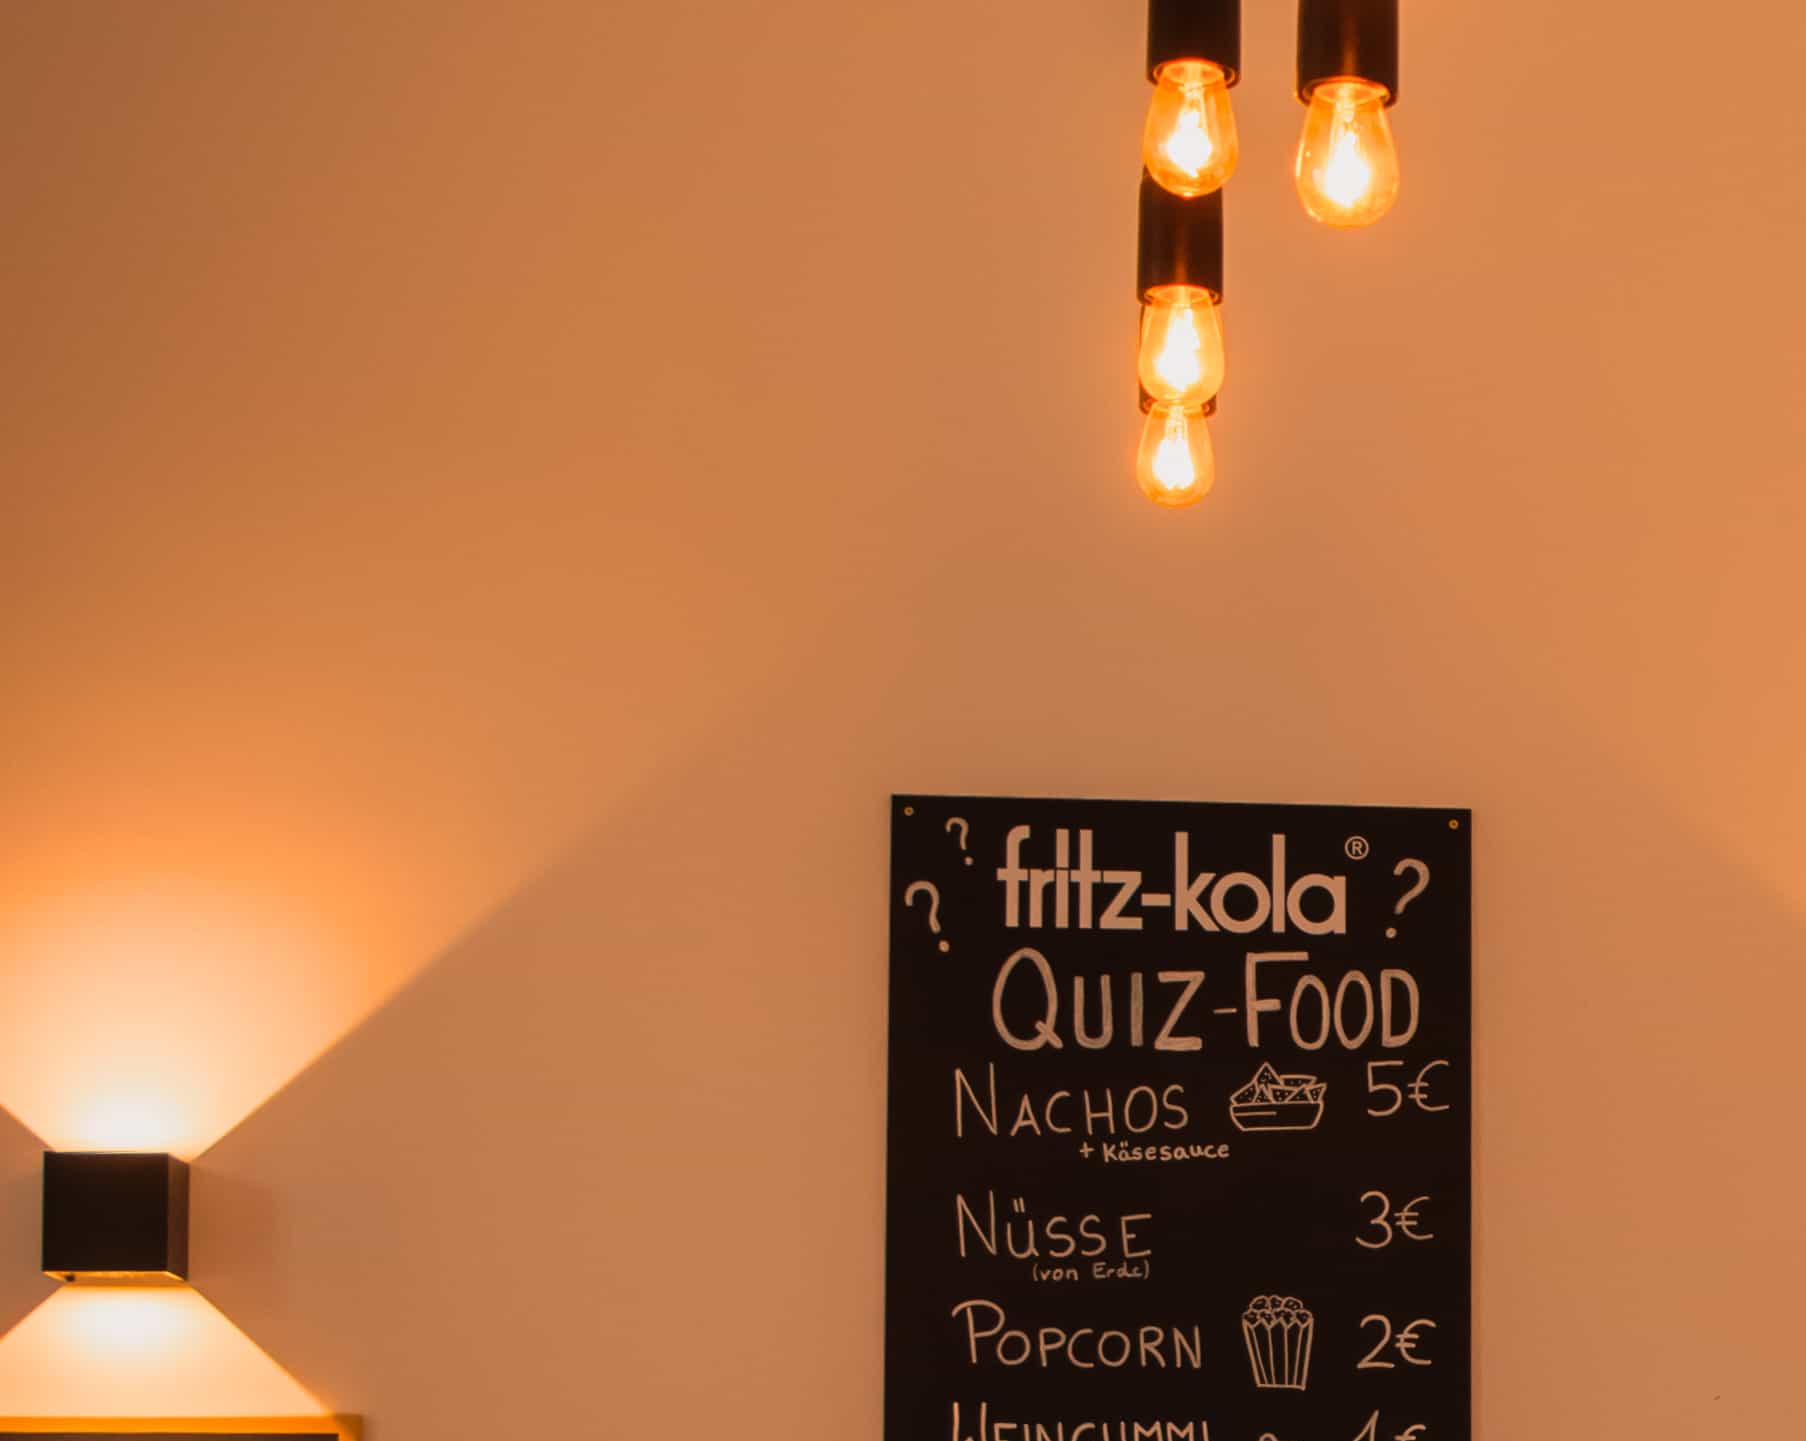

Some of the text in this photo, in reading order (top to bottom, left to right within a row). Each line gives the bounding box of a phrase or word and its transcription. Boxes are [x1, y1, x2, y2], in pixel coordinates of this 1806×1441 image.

[954, 1061, 1189, 1138] NACHOS
[1079, 1140, 1231, 1163] + Käsesauce
[1032, 1263, 1079, 1282] (von
[951, 1299, 1202, 1369] POPCORN
